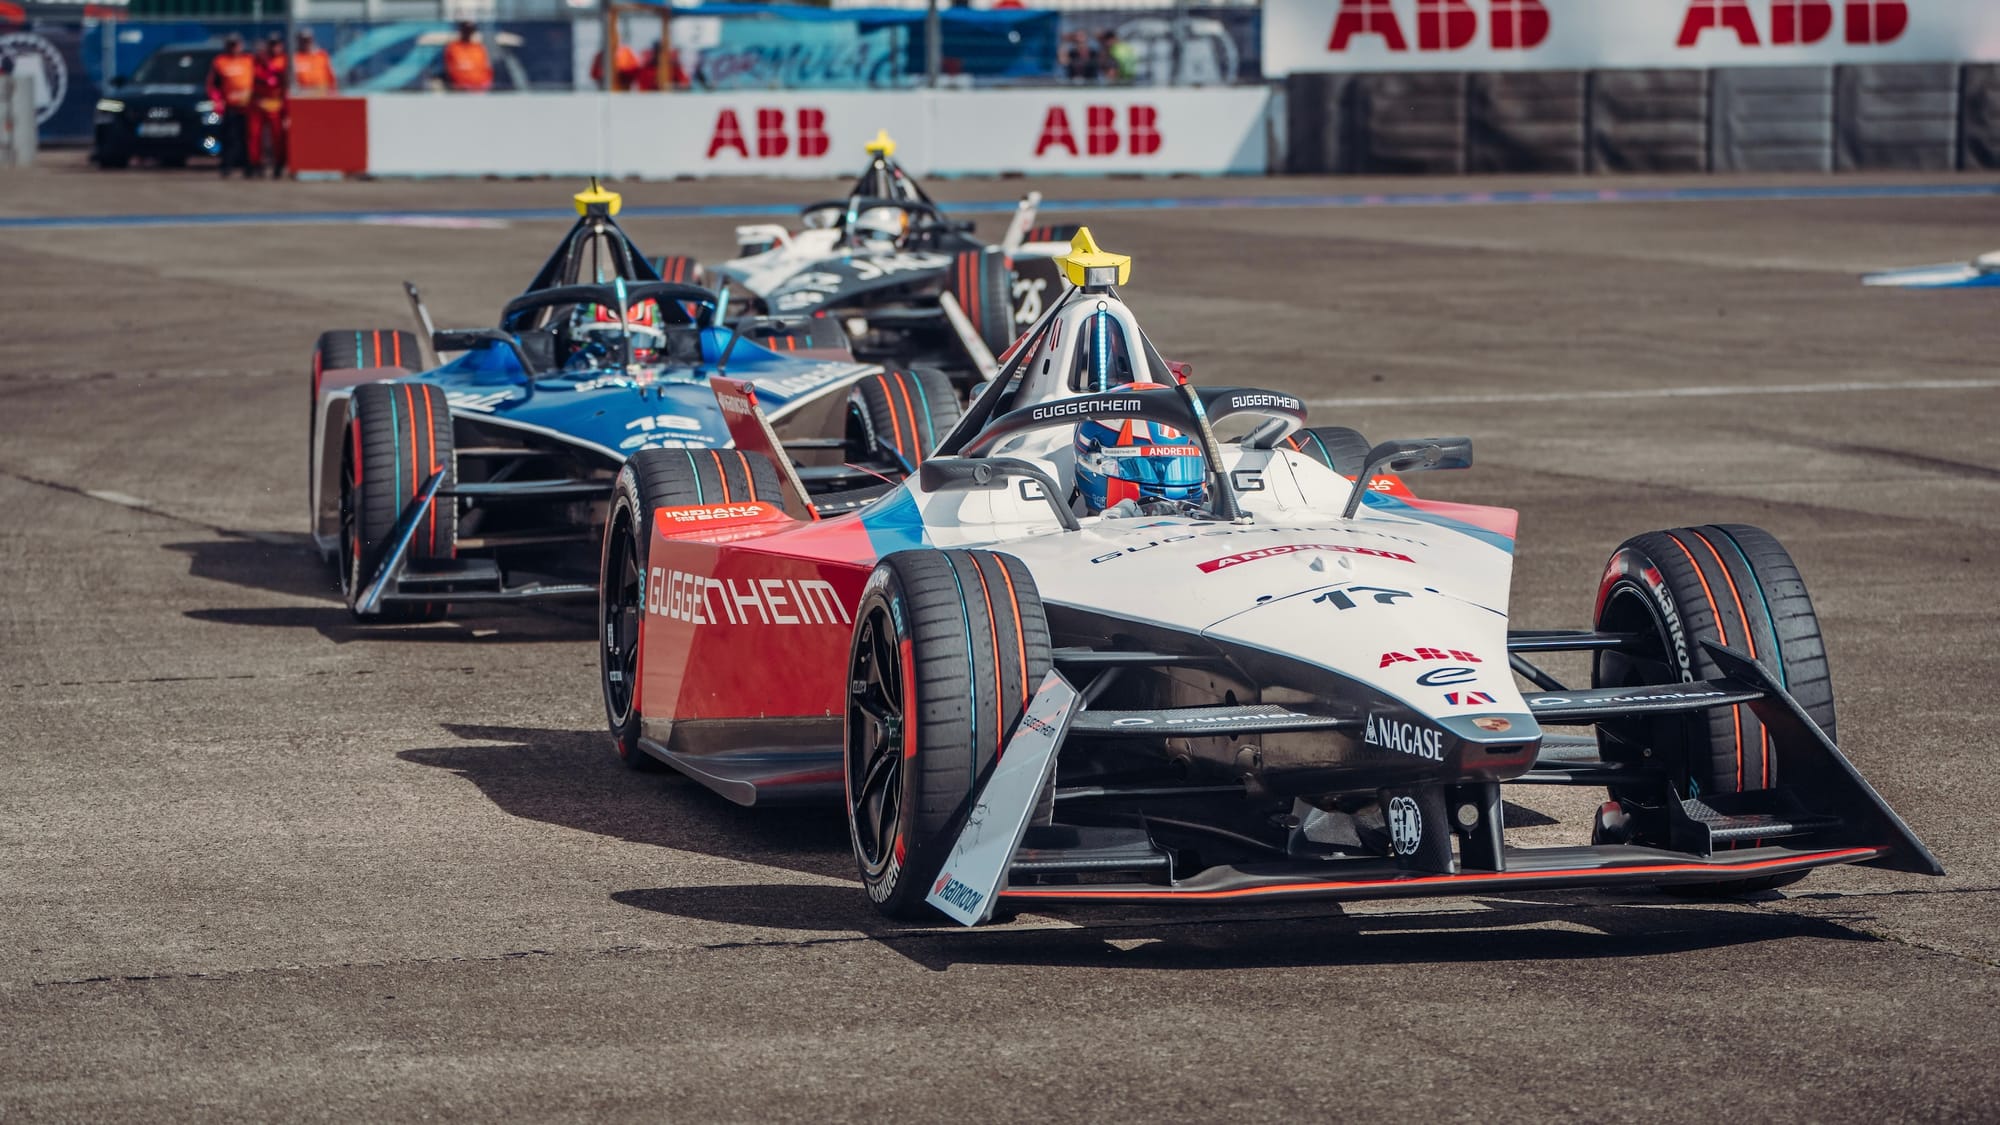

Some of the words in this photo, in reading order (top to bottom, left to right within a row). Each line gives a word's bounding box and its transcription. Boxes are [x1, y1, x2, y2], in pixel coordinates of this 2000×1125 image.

[1329, 0, 1549, 51] ABB
[1678, 0, 1907, 47] ABB
[708, 109, 829, 157] ABB
[1036, 106, 1161, 155] ABB
[1033, 400, 1141, 420] GUGGENHEIM
[1232, 395, 1300, 410] GUGGENHEIM
[1149, 447, 1195, 456] ANDRETTI
[1231, 470, 1265, 491] G
[665, 505, 764, 518] INDIANA
[697, 511, 759, 520] BOLD
[1216, 545, 1402, 568] ANDRETTI
[649, 567, 852, 625] GUGGENHEIM
[1312, 586, 1413, 611] 17
[1652, 583, 1694, 684] Hankoo
[1379, 648, 1483, 669] ABB
[1379, 716, 1444, 762] NAGASE
[939, 878, 985, 915] Hankook
